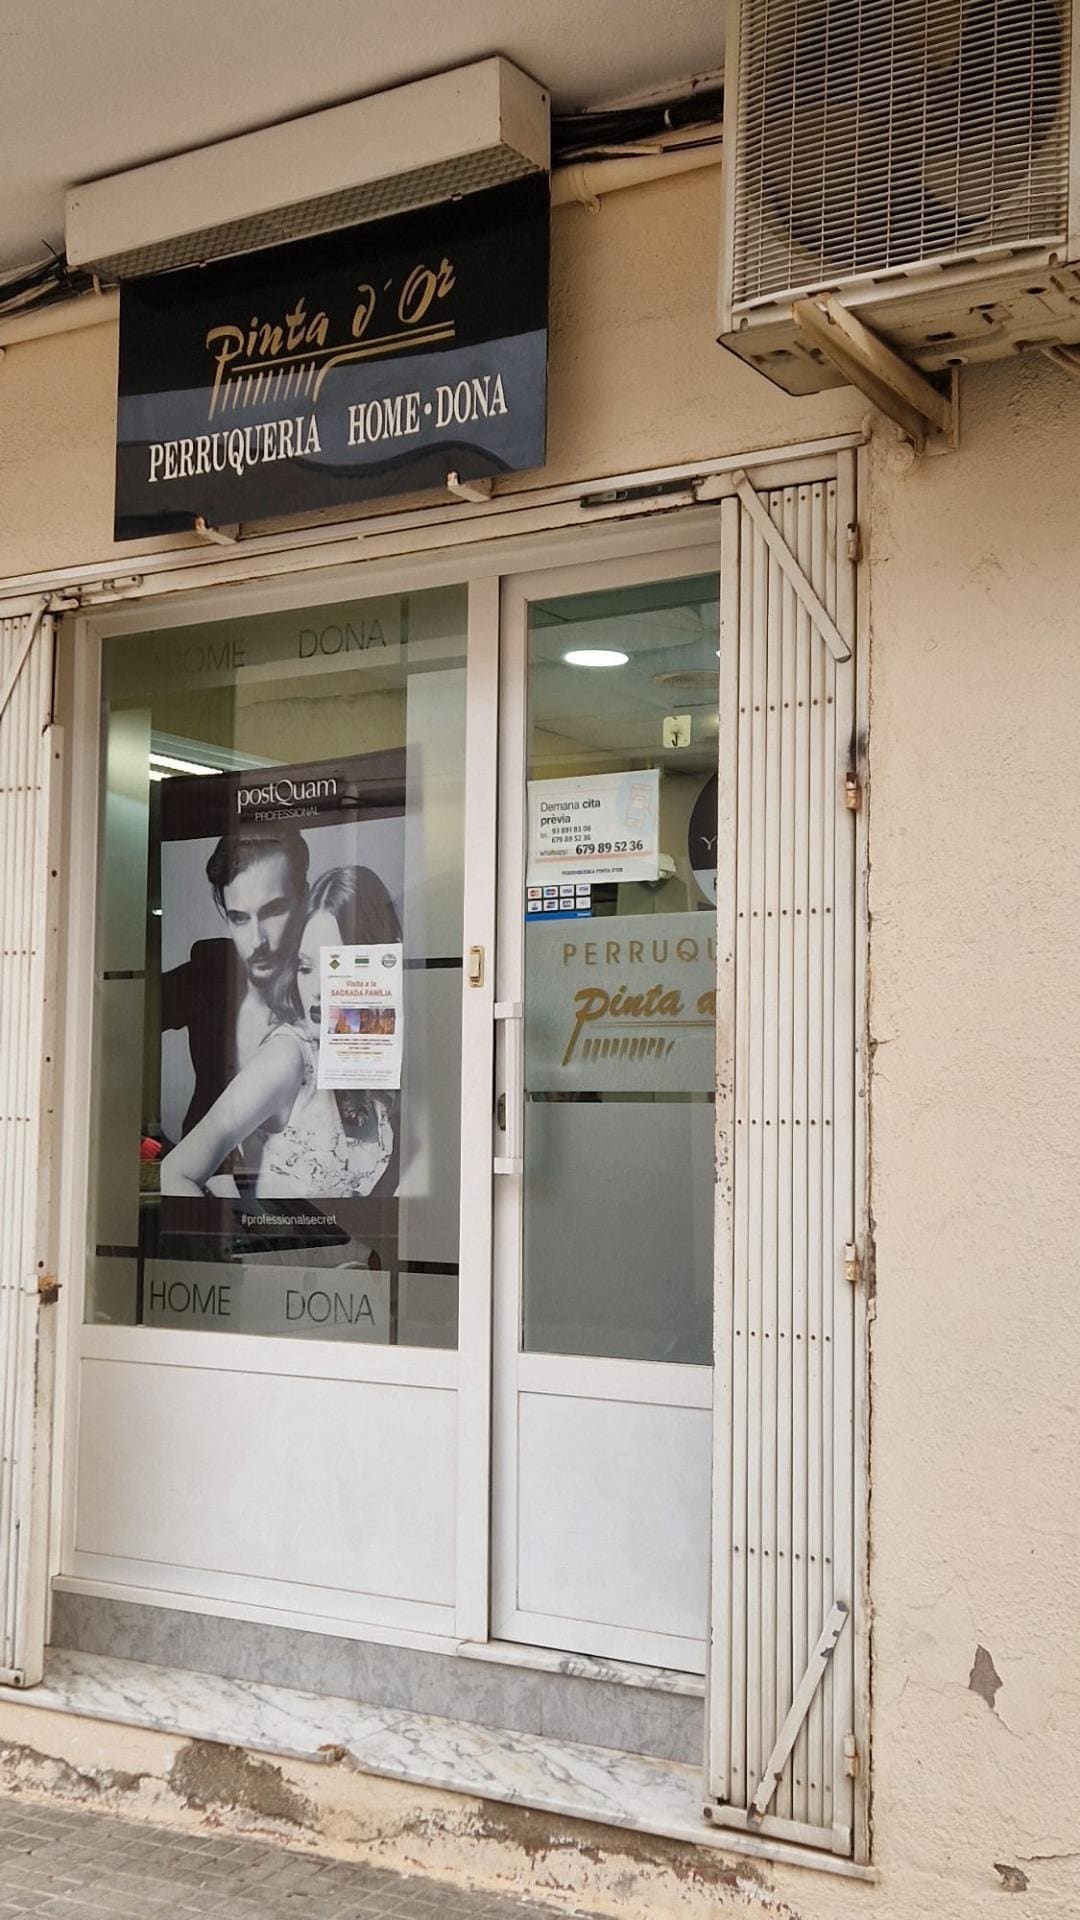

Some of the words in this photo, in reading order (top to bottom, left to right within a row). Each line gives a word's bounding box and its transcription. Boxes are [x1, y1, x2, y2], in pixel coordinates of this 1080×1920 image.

[206, 297, 329, 421] Pinta
[147, 414, 321, 483] PERRUQUERIA
[298, 619, 387, 659] DONA
[237, 779, 337, 814] postQuam
[540, 801, 580, 812] Demana
[582, 798, 601, 809] cita
[255, 806, 320, 821] PROFESSIONAL
[540, 813, 571, 827] prèvia
[575, 843, 596, 855] 679
[597, 842, 612, 853] 89
[614, 841, 628, 852] 52
[629, 840, 644, 851] 36
[331, 989, 364, 998] SAGRADA
[562, 983, 685, 1066] Pinta
[241, 1213, 337, 1228] #professionalsecret
[150, 1280, 232, 1316] HOME
[286, 1289, 376, 1326] DONA
